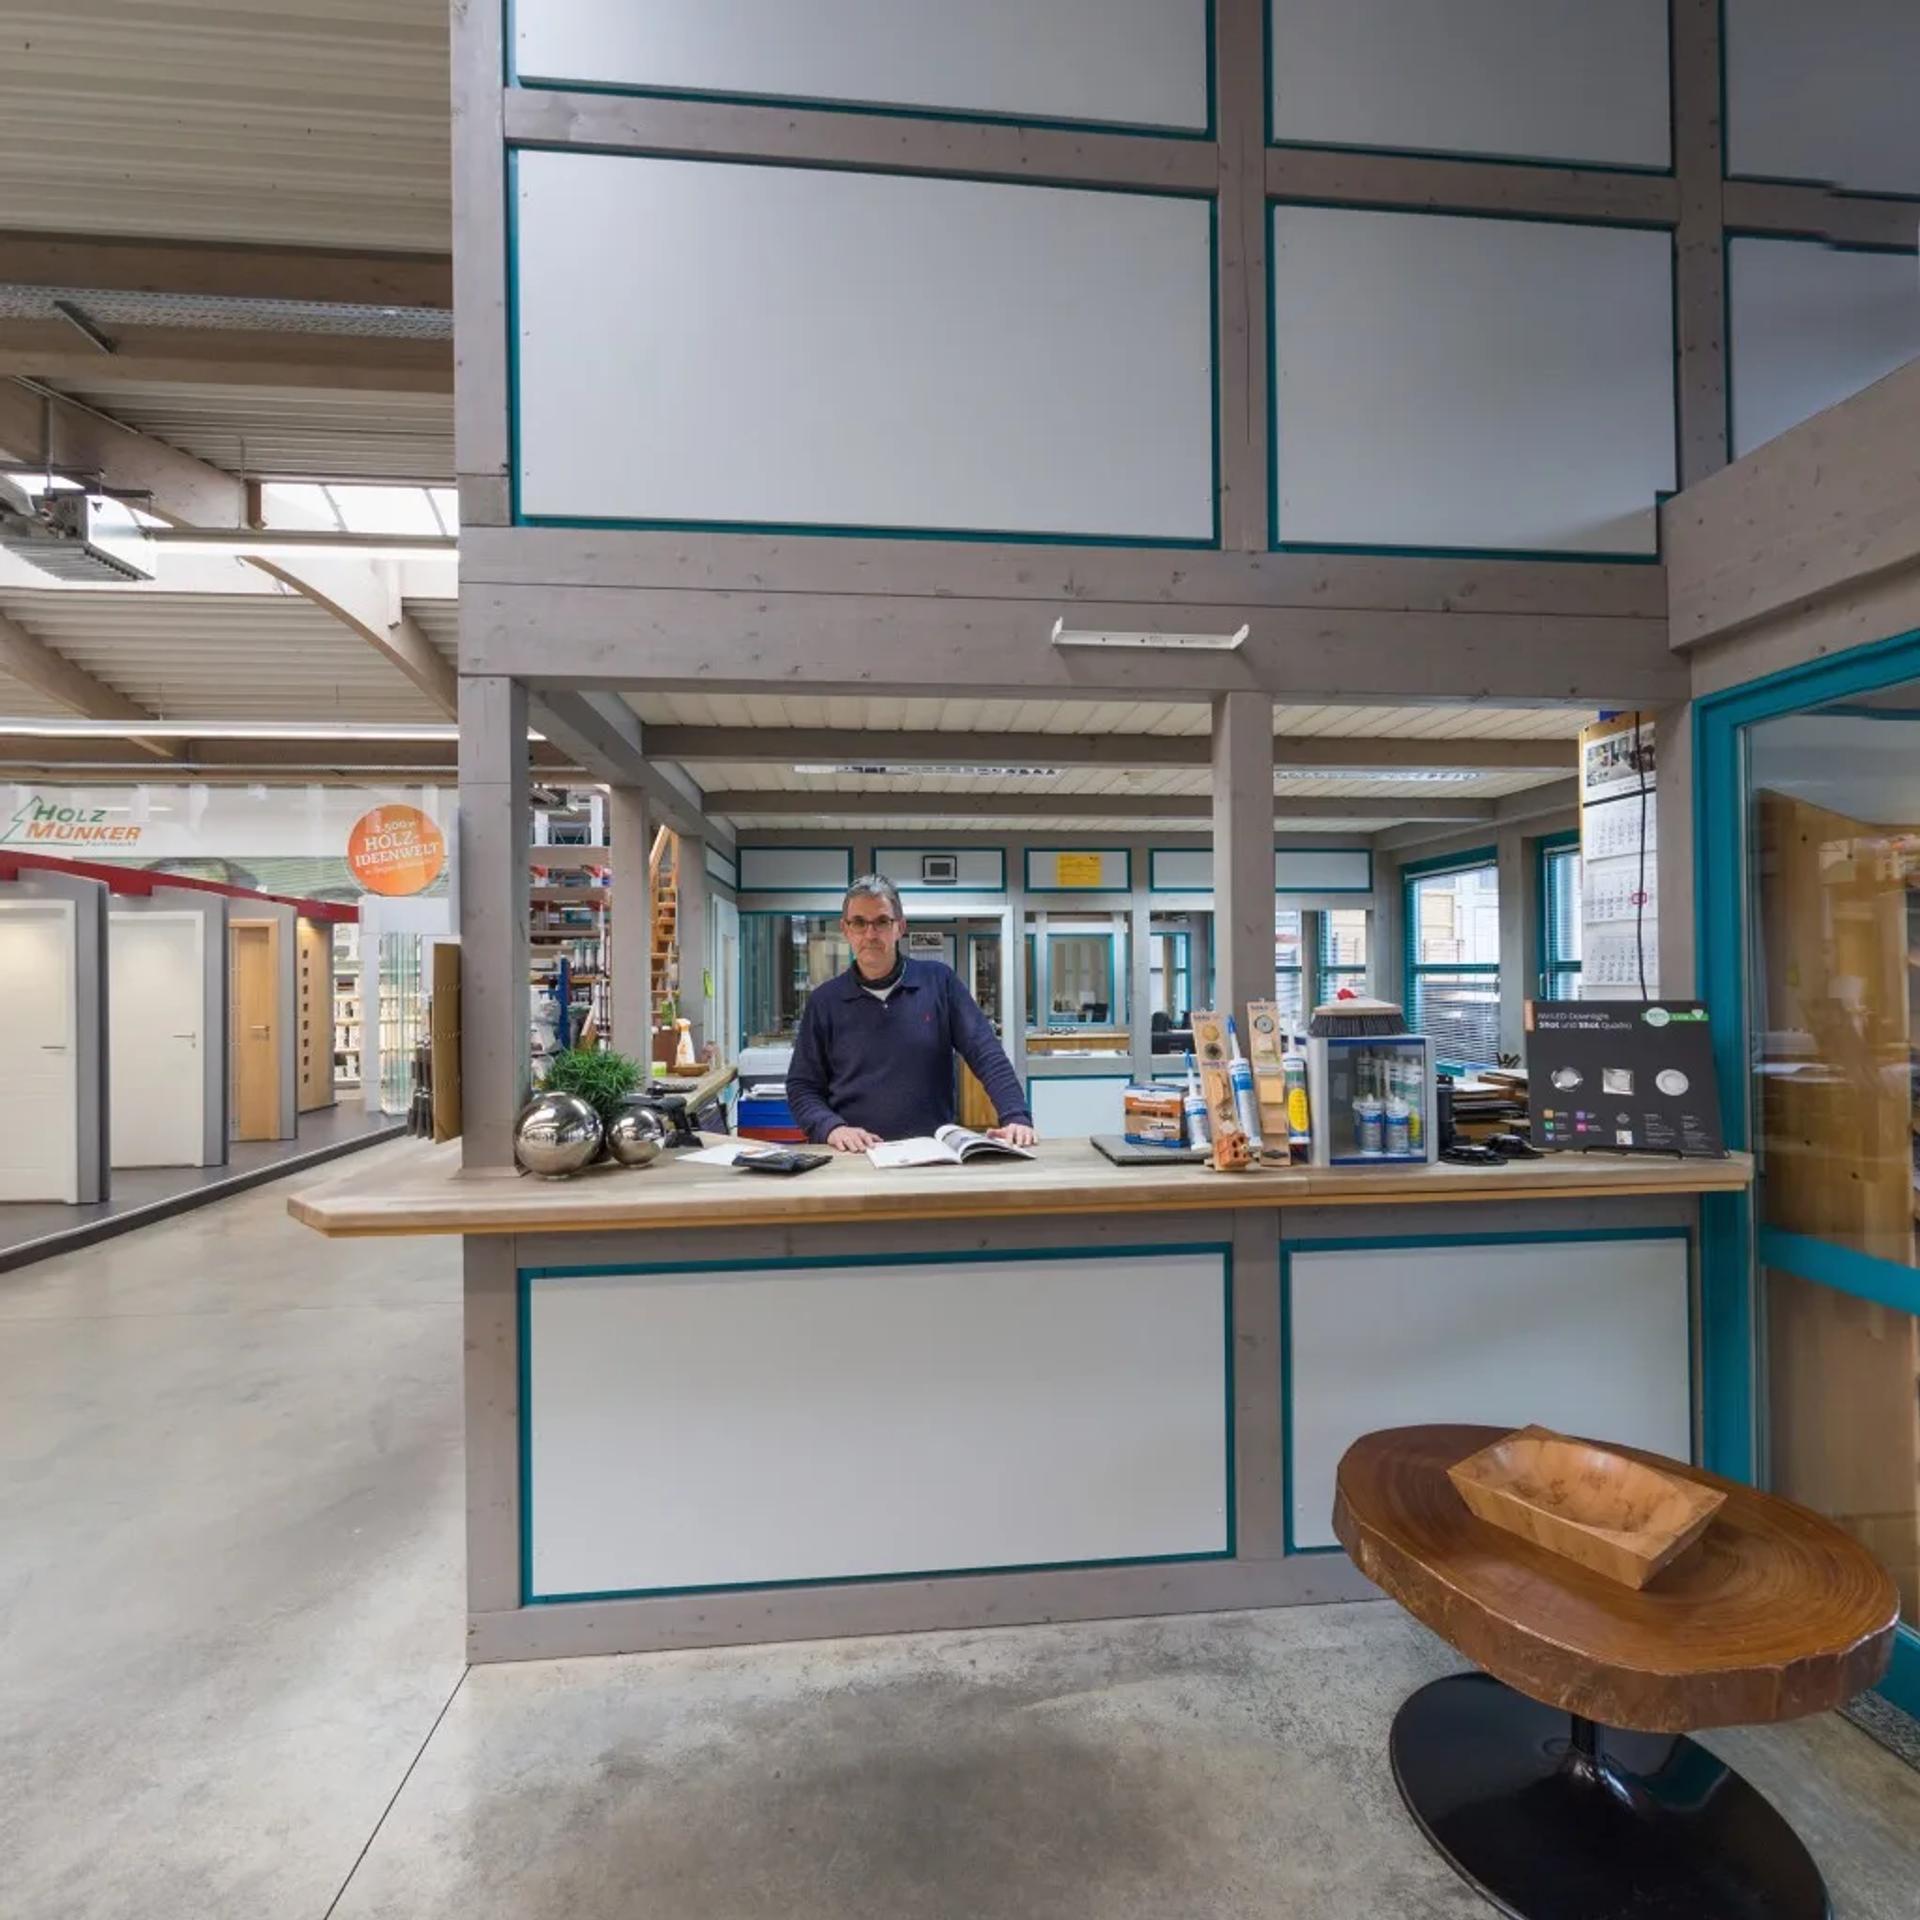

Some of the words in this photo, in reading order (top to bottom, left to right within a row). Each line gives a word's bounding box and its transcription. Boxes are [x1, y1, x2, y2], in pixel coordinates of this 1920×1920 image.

[33, 804, 107, 822] HOLZ
[26, 821, 141, 840] MÜNKER
[355, 841, 439, 867] IDEENWELT
